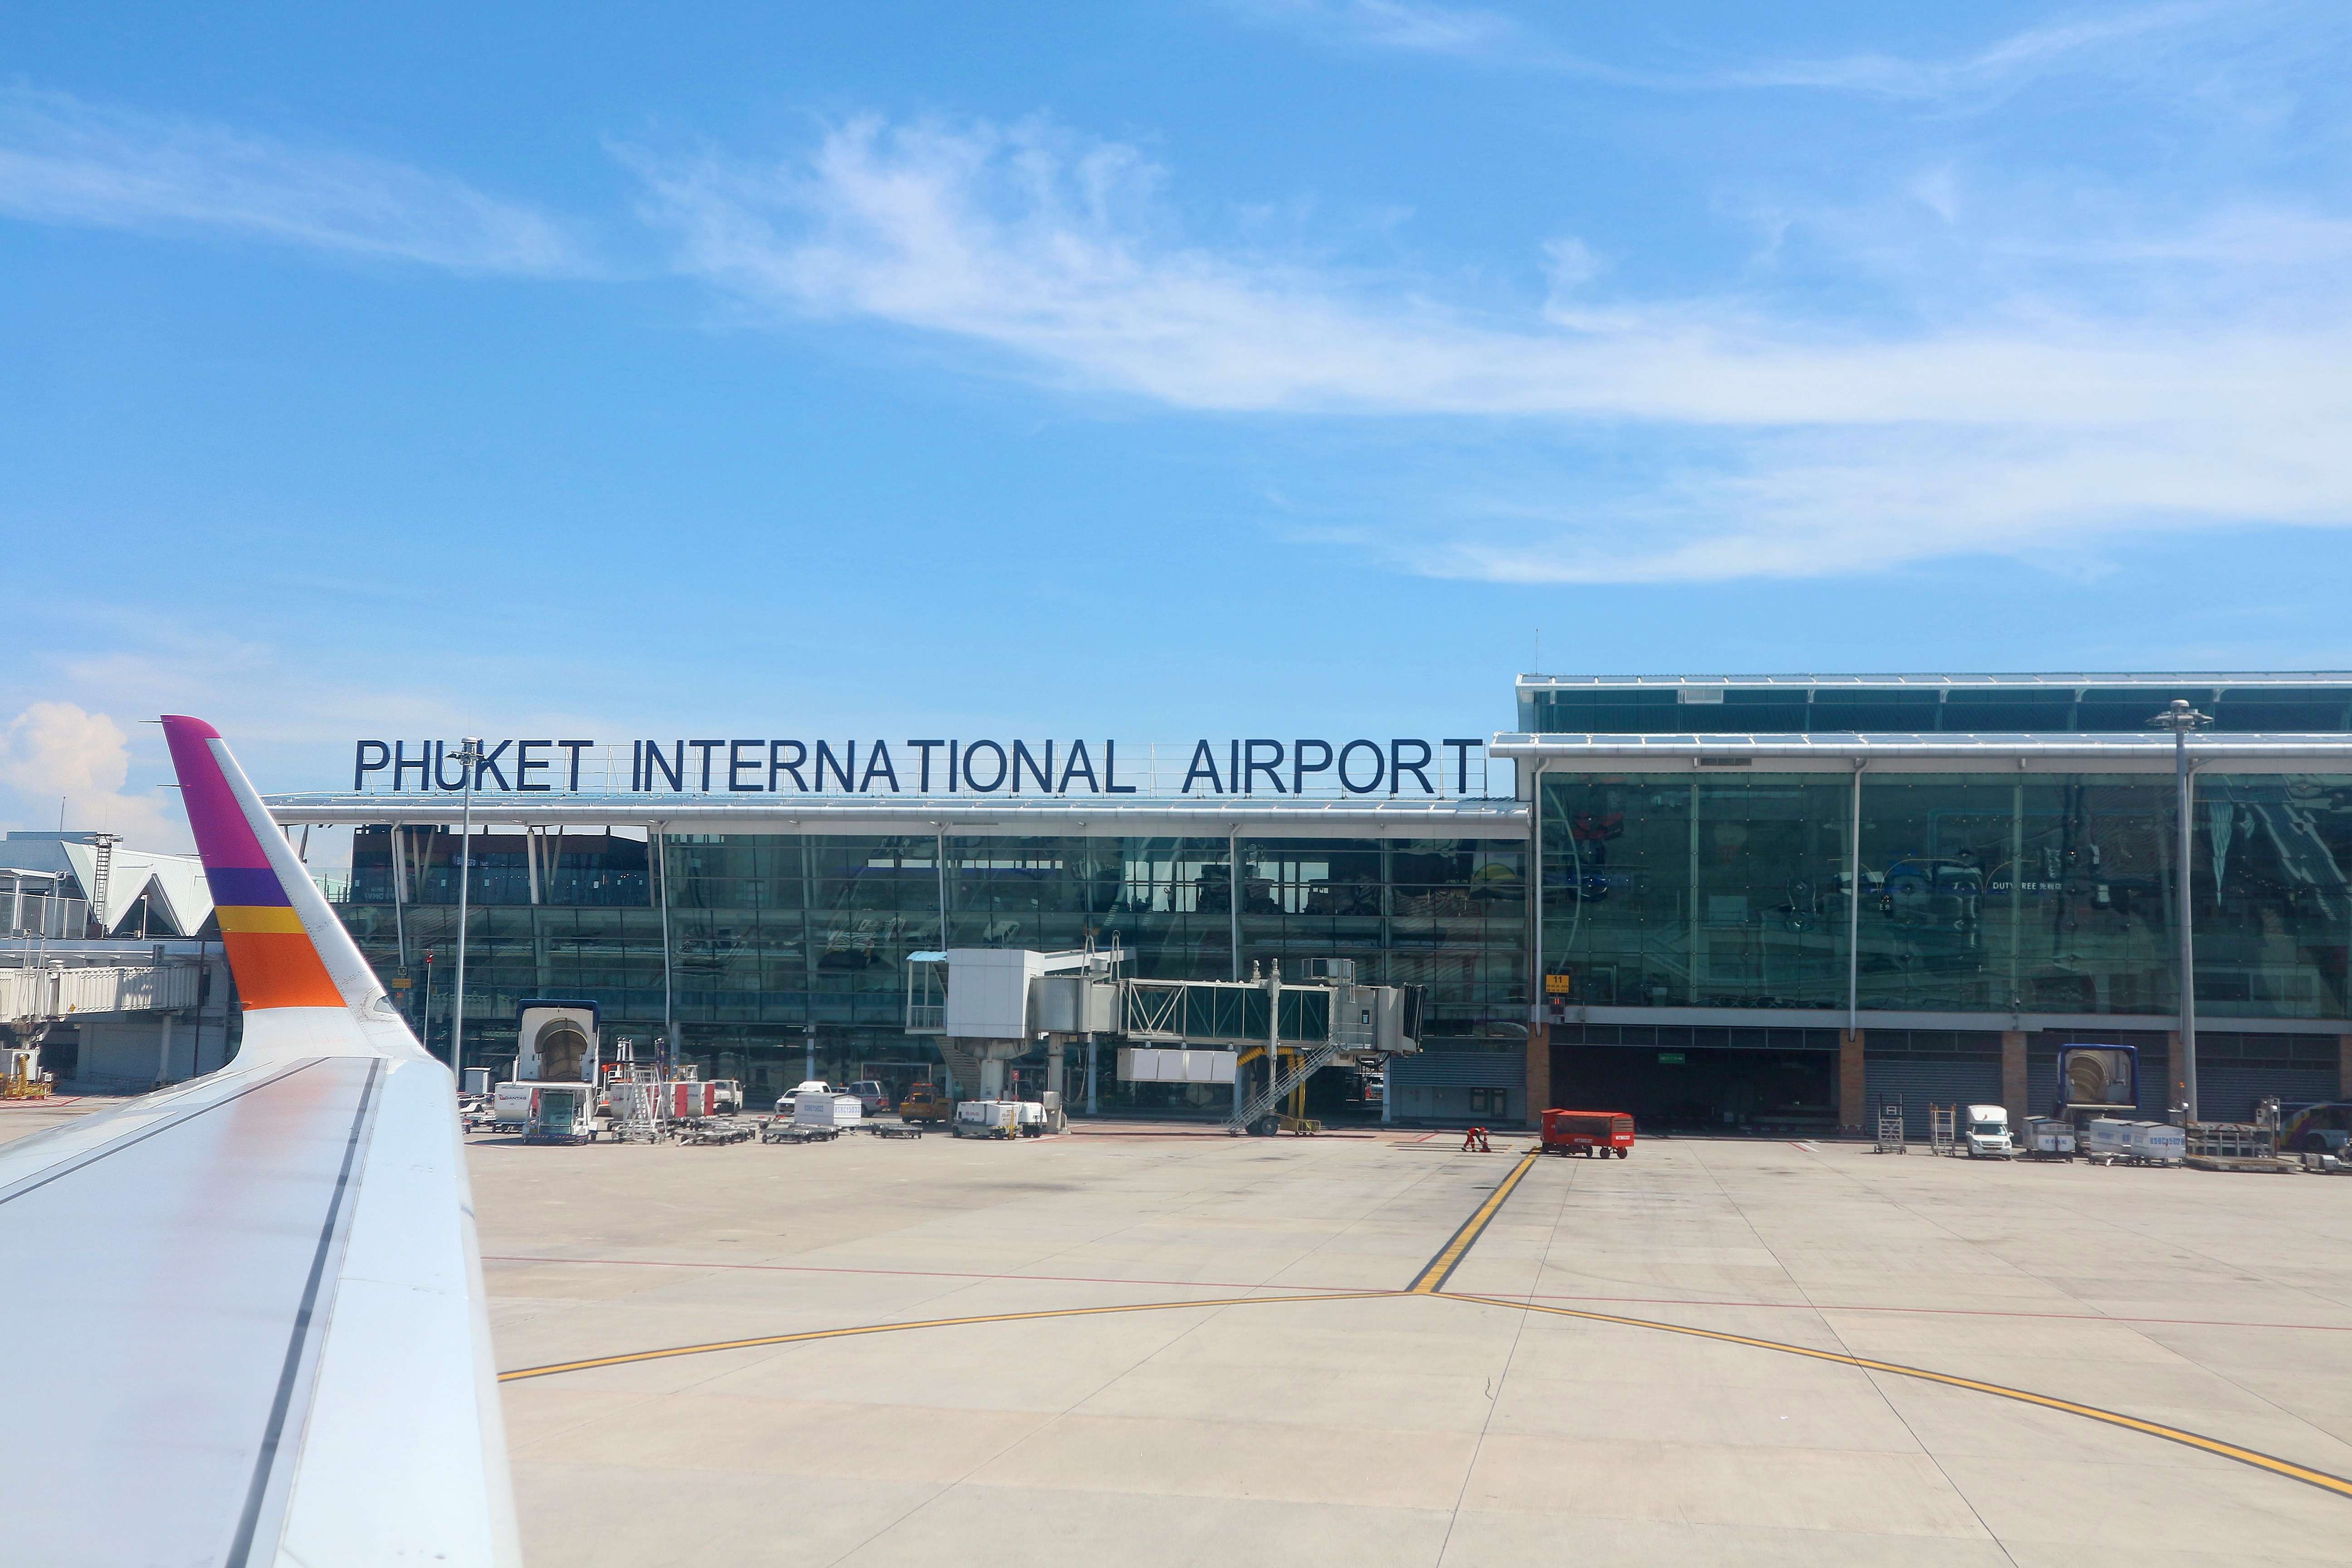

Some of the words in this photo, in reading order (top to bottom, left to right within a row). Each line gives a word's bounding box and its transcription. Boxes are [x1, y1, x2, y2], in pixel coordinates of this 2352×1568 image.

[354, 740, 594, 792] PHUKET
[632, 740, 1137, 793] INTERNATIONAL
[1181, 739, 1483, 794] AIRPORT
